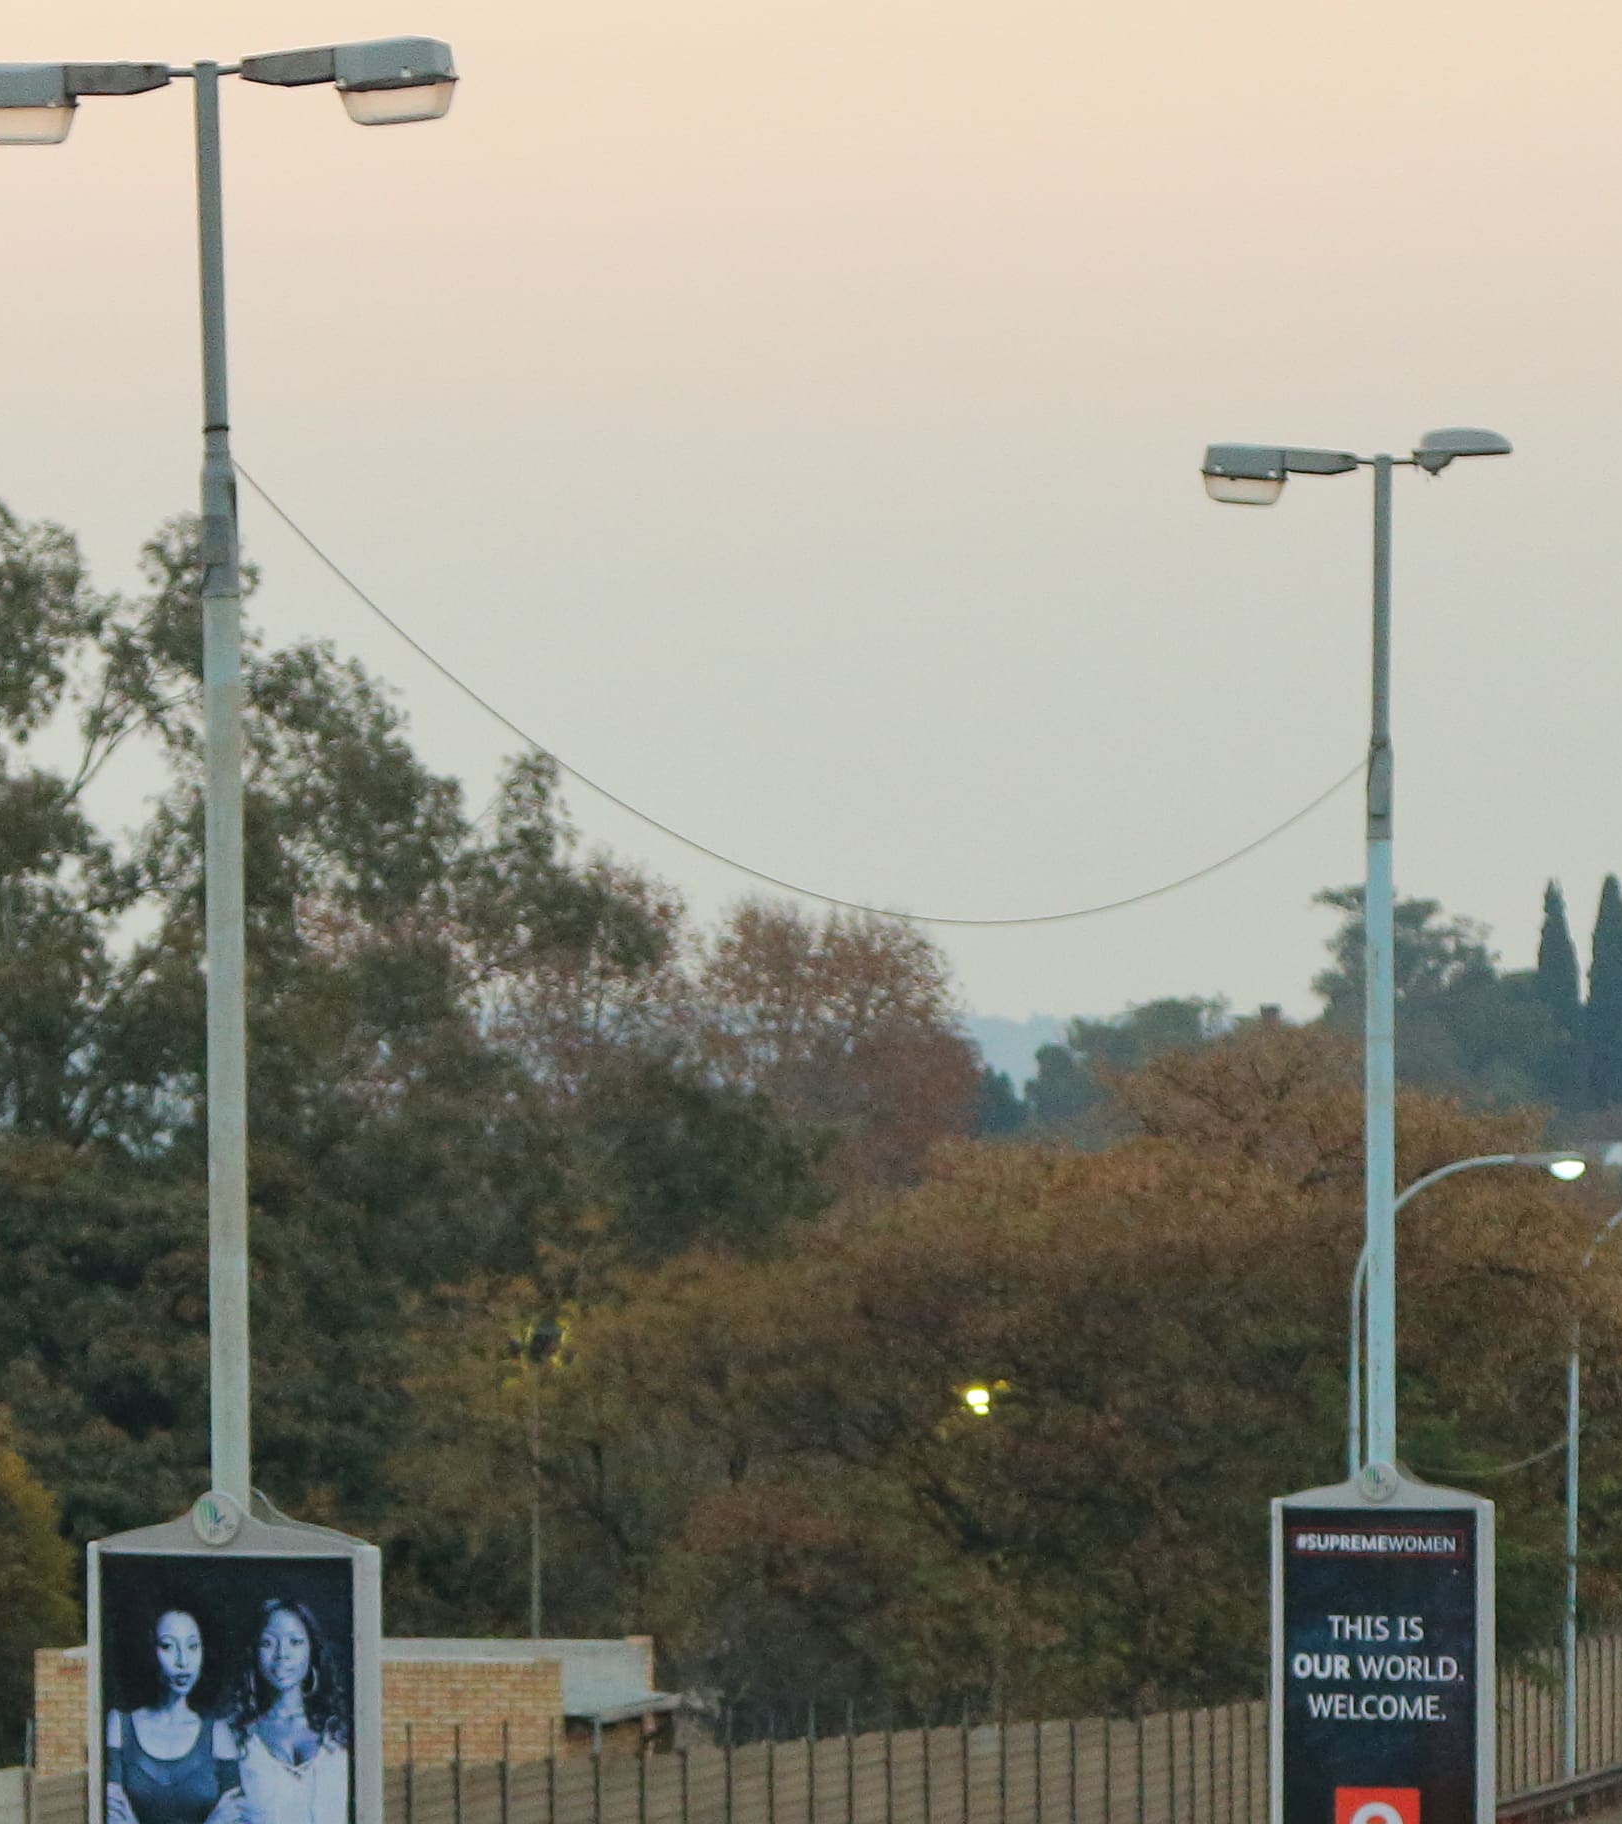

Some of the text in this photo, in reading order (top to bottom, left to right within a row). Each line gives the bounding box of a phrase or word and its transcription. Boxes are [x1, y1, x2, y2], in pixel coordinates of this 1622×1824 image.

[1296, 1533, 1457, 1553] #SUPREMEWOMEN
[1329, 1614, 1424, 1642] THIS IS
[1293, 1653, 1465, 1682] OUR WORLD.
[1308, 1692, 1447, 1721] WELCOME.
